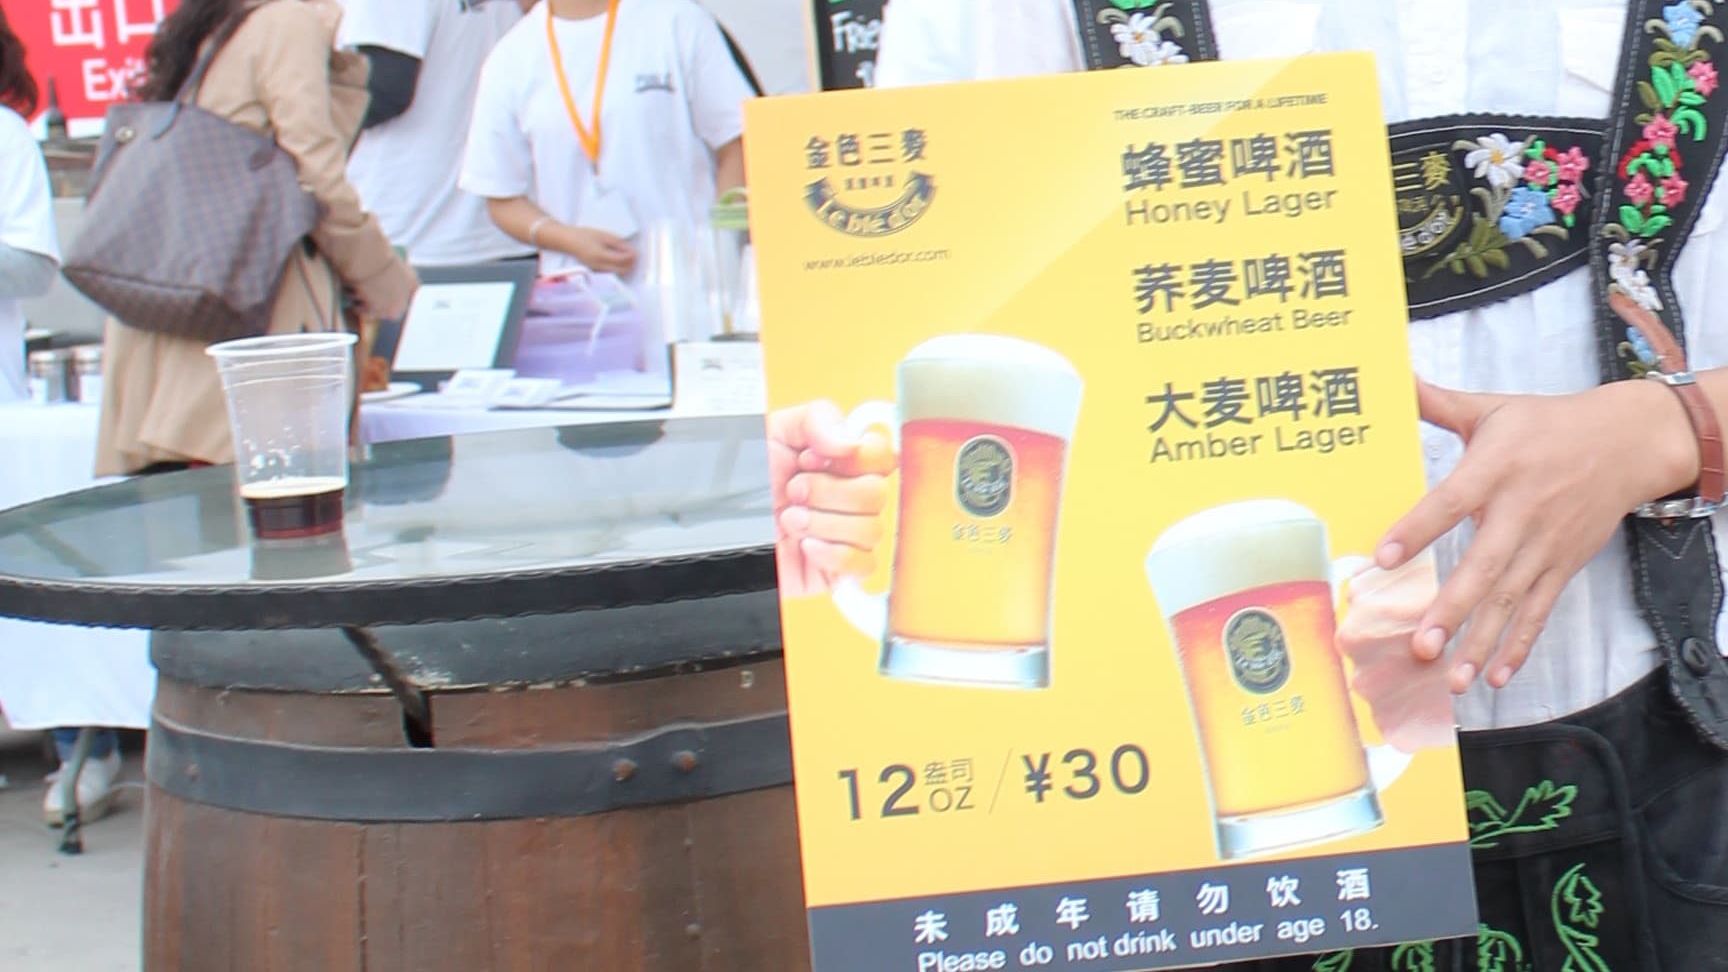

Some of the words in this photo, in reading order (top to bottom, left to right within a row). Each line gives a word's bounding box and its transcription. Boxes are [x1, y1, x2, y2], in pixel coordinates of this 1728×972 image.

[1113, 108, 1140, 121] THE
[1122, 129, 1335, 193] 蜂蜜啤酒
[1125, 193, 1231, 226] Honey
[1243, 188, 1337, 217] Lager
[1132, 249, 1349, 314] 荞麦啤酒
[1137, 314, 1284, 344] Buckwheat
[1292, 307, 1353, 330] Beer
[1145, 366, 1362, 433] 大麦啤酒
[1150, 433, 1262, 464] Amber
[1276, 422, 1371, 453] Lager
[837, 763, 920, 821] 12
[924, 757, 974, 786] 盎司
[929, 785, 976, 813] OZ
[1021, 743, 1150, 803] ¥30
[913, 868, 1370, 943] 未成年请勿饮酒
[917, 944, 1007, 972] Please
[1019, 939, 1053, 967] do
[1066, 938, 1109, 961] not
[1113, 928, 1178, 957] drink
[1190, 921, 1264, 949] under
[1277, 915, 1326, 943] age
[1340, 907, 1380, 933] 18.
